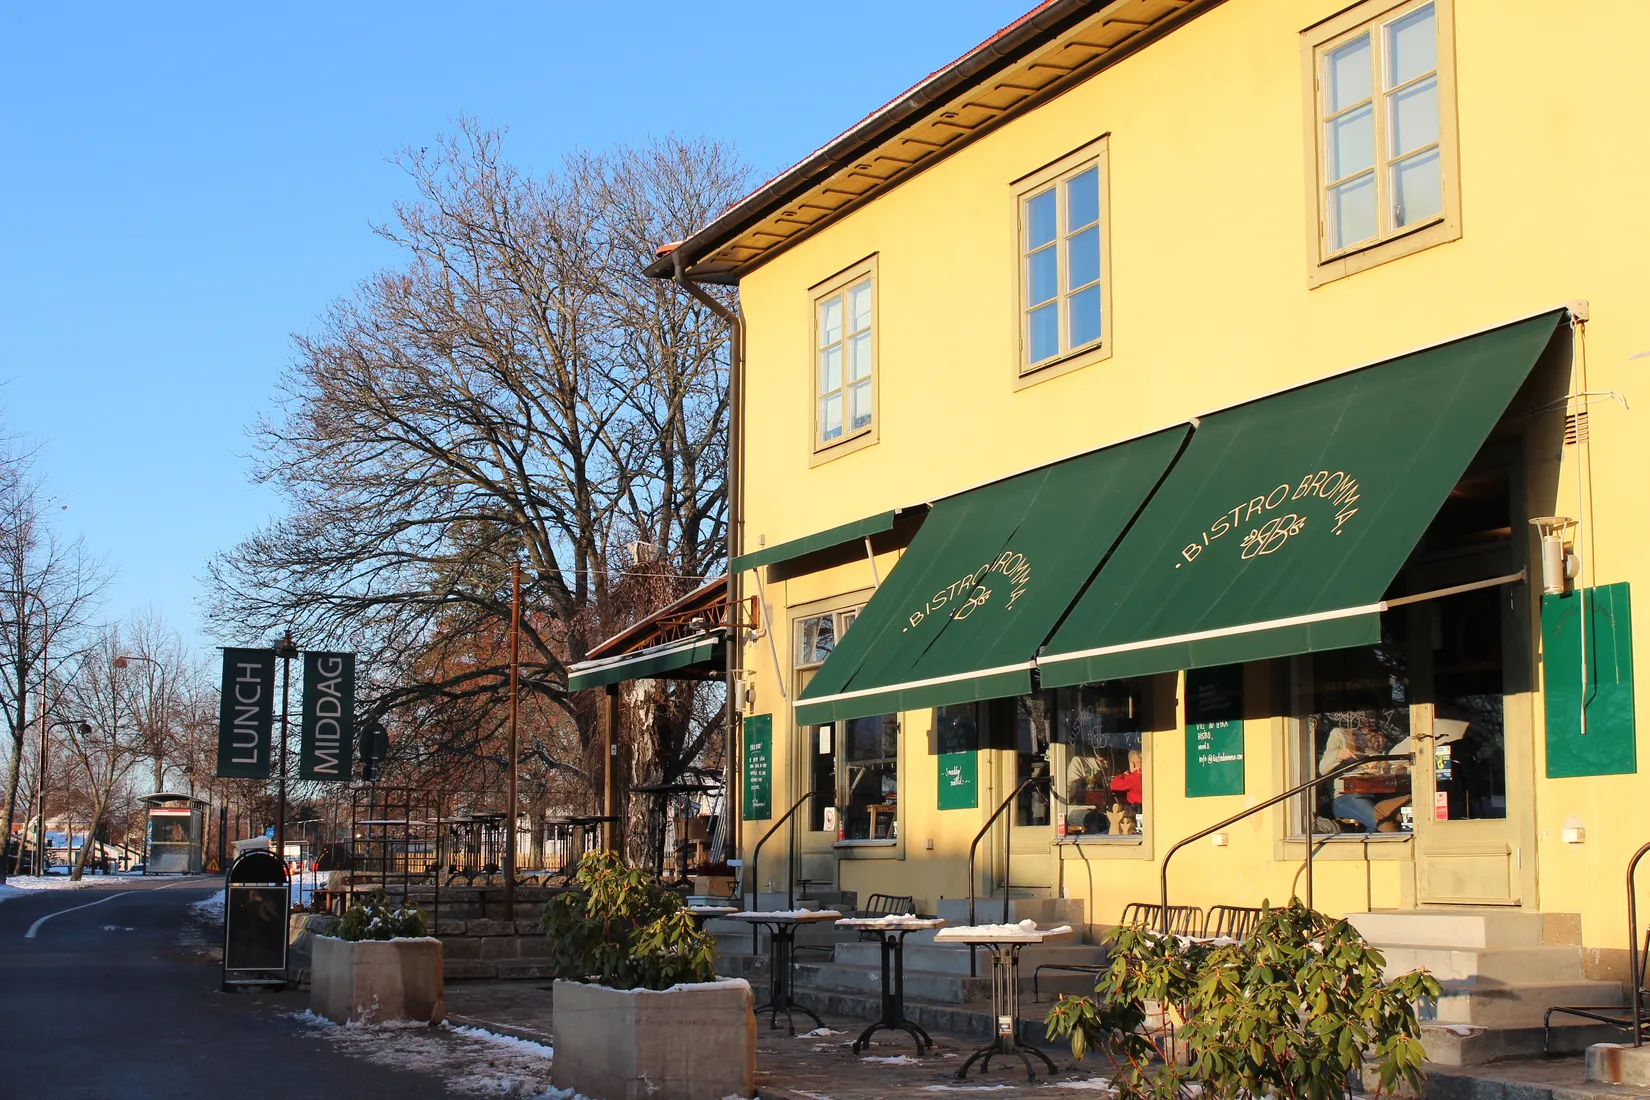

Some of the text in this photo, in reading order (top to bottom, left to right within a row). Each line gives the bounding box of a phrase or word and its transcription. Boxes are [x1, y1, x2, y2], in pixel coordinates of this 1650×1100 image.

[1182, 470, 1361, 562] BISTRO BROMMA
[988, 551, 1031, 608] ROMMA
[232, 663, 262, 764] LUNCH
[313, 657, 343, 774] MIDDAG
